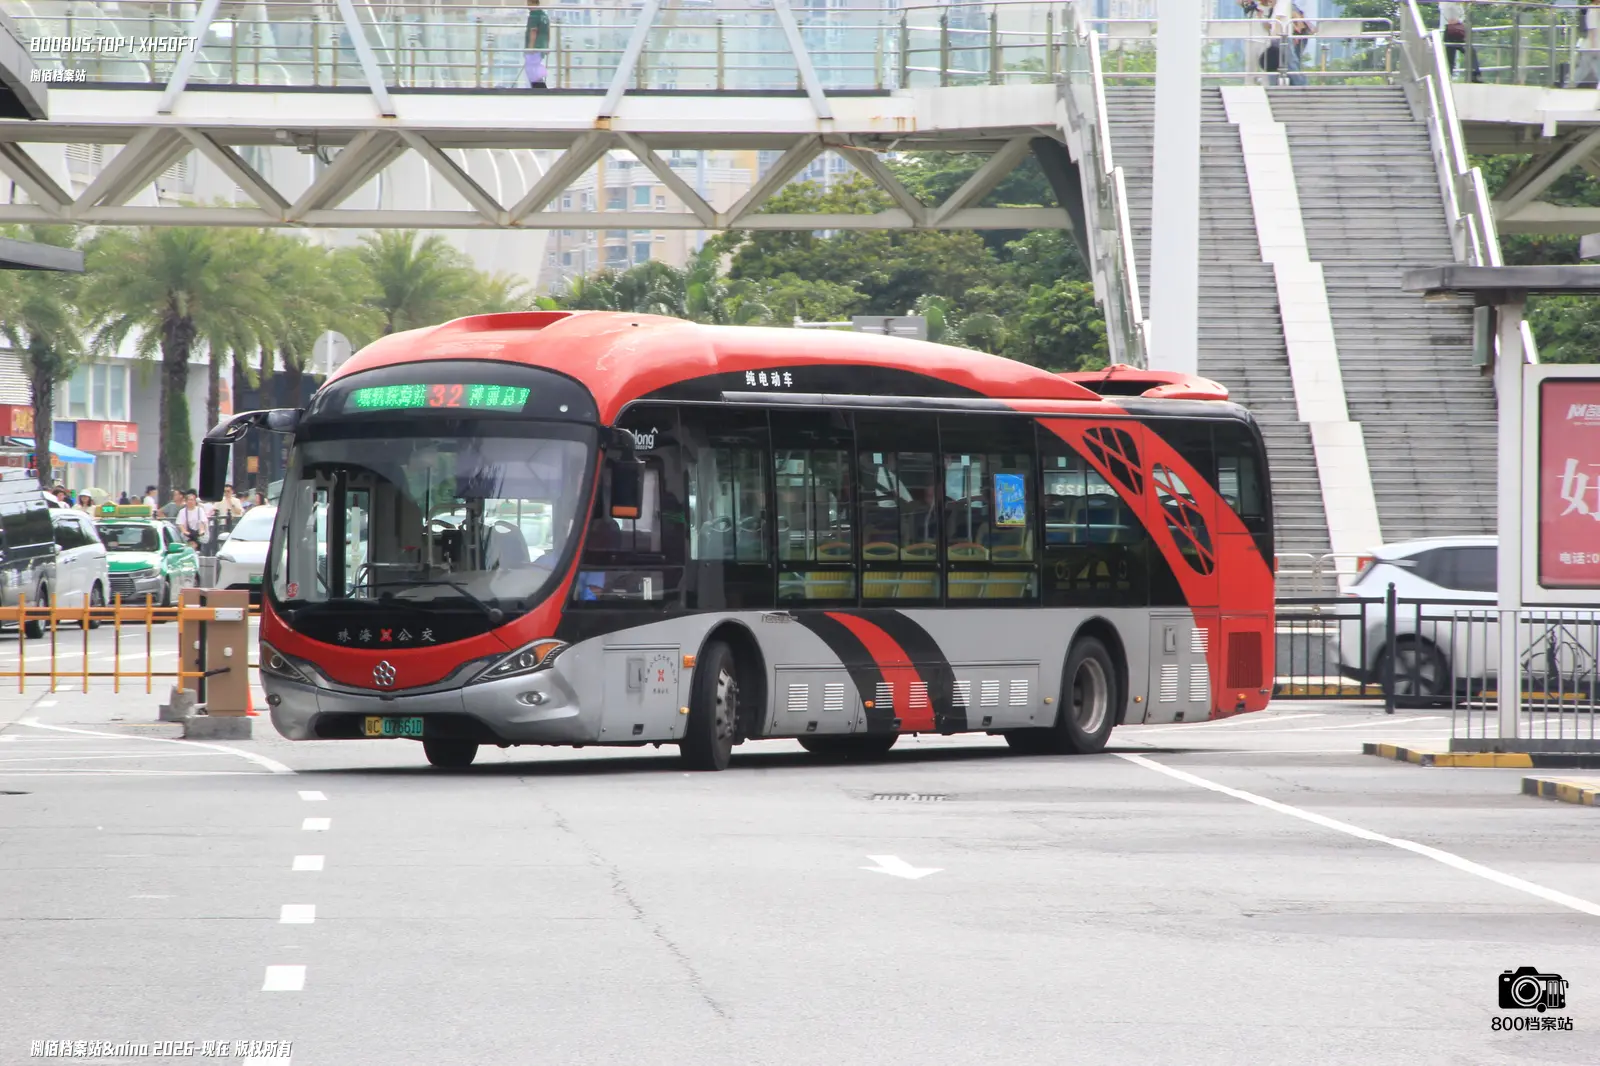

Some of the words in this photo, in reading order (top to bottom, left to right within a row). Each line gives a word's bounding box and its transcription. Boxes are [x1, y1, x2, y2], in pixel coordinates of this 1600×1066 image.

[745, 370, 793, 387] 纯电动车
[429, 383, 463, 407] 32
